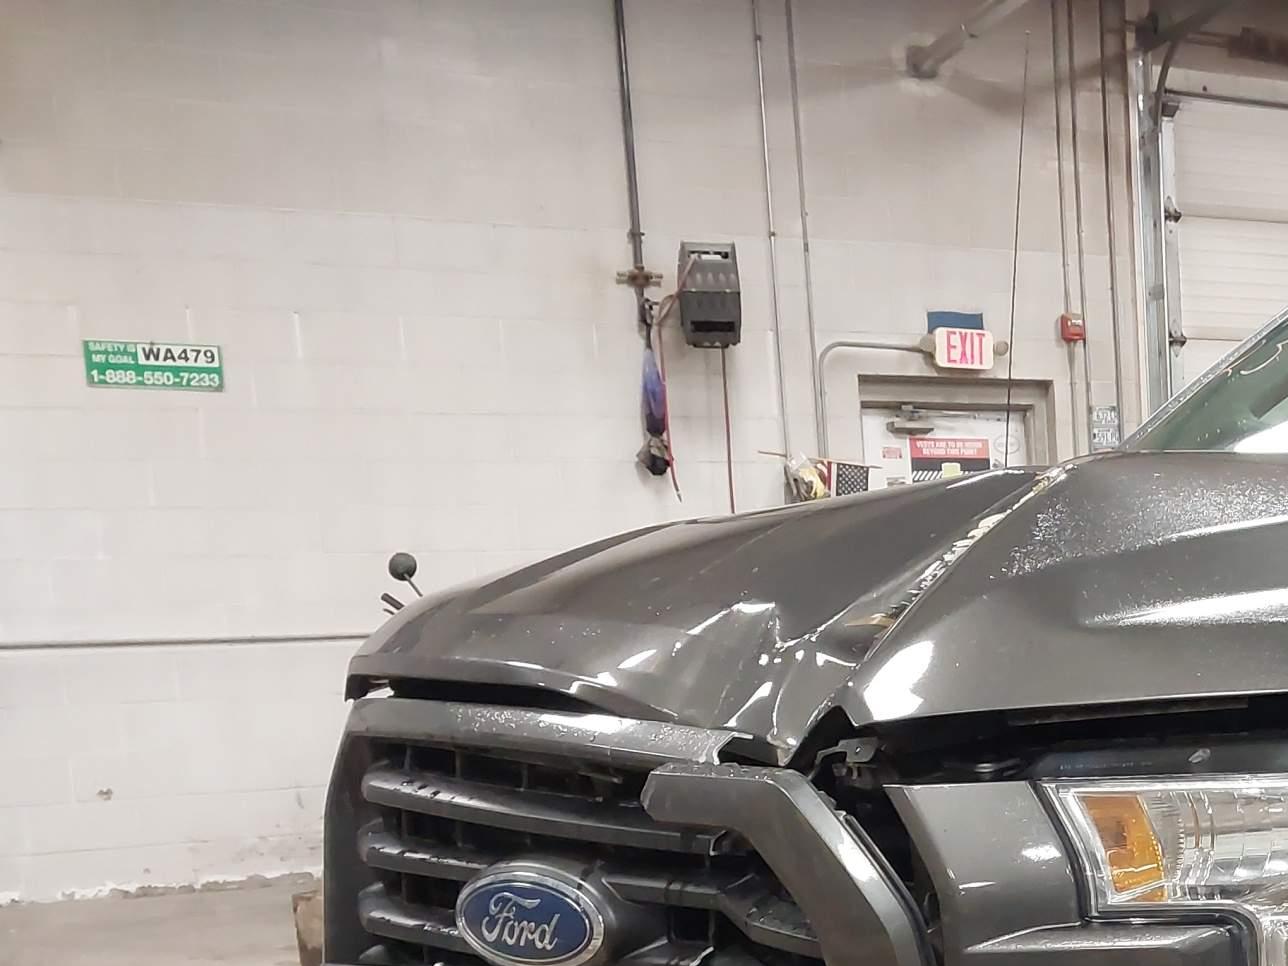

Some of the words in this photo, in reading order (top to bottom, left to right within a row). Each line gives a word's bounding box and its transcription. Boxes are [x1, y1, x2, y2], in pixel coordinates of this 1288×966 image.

[88, 342, 125, 352] SAFETY
[127, 344, 136, 352] IS
[141, 346, 215, 365] WA479
[946, 330, 985, 365] EXIT
[91, 353, 106, 364] MY
[108, 354, 135, 365] GOAL
[91, 368, 219, 387] 1-888-550-7233
[481, 892, 561, 951] Ford
